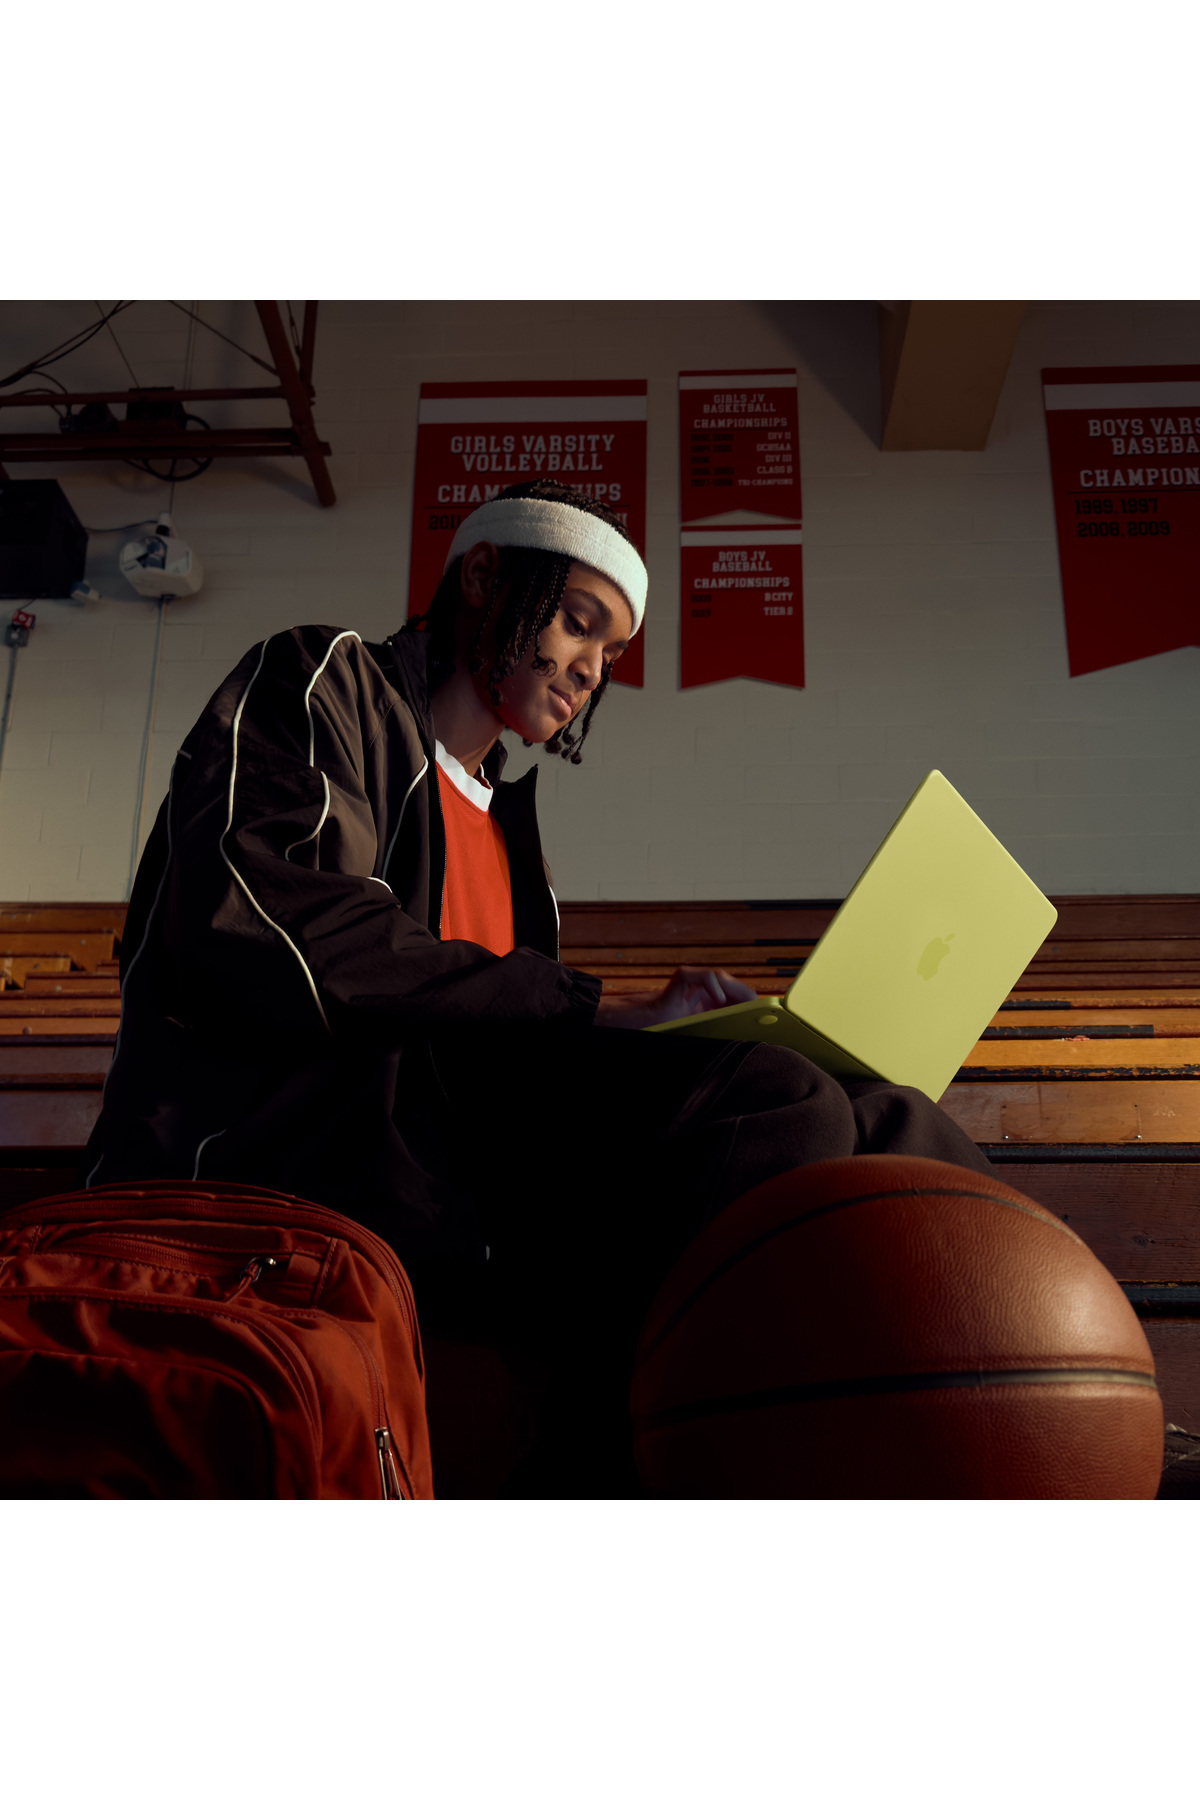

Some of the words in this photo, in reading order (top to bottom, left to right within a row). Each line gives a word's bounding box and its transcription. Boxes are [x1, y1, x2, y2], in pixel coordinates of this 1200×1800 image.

[713, 394, 747, 404] GIRLS
[749, 393, 765, 403] JV
[703, 402, 776, 414] BASKETBALL
[693, 417, 788, 429] CHAMPIONSHIPS
[1087, 418, 1144, 437] BOYS
[450, 435, 516, 454] GIRLS
[521, 434, 615, 453] VARSITY
[1111, 436, 1200, 456] BASEBA
[462, 453, 603, 472] VOLLEYBALL
[1080, 467, 1200, 488] CHAMPION
[437, 483, 622, 502] CHAMIPS
[718, 551, 748, 561] BOYS
[750, 550, 766, 561] JV
[712, 561, 773, 572] BASEBALL
[693, 577, 790, 589] CHAMPIONSHIPS
